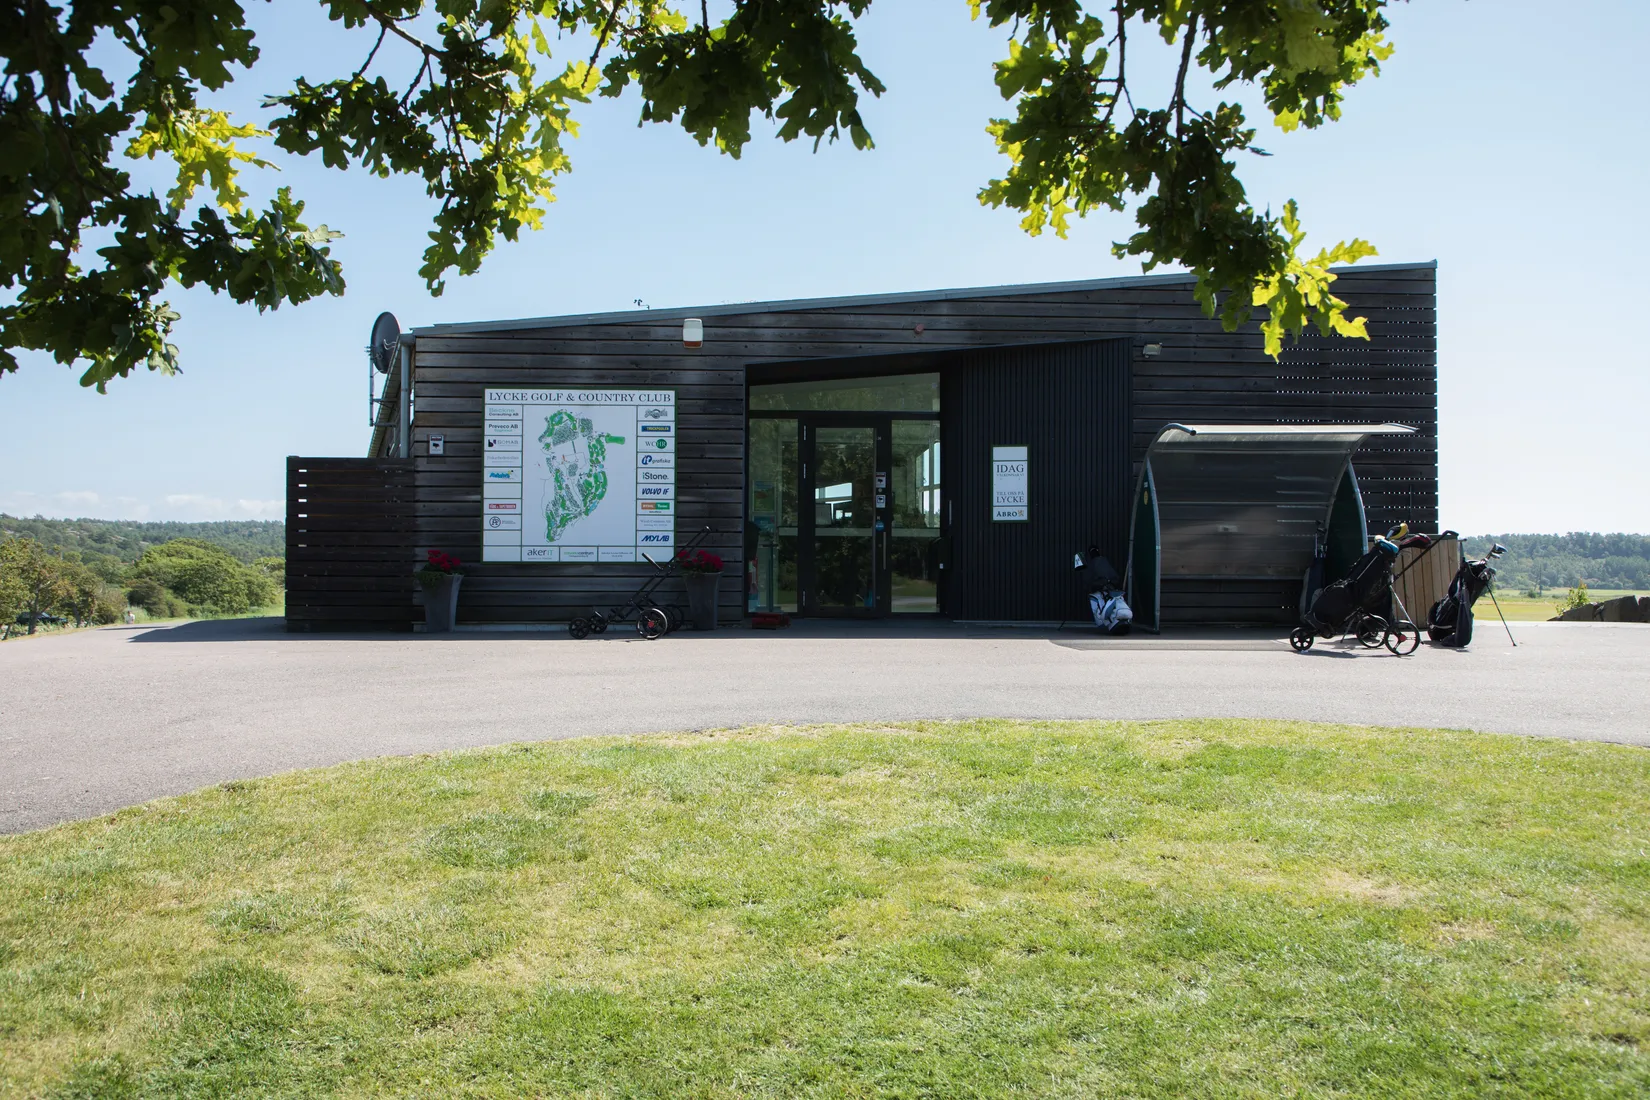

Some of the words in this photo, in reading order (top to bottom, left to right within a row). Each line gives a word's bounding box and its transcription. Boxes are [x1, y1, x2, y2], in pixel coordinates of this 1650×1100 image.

[489, 393, 528, 401] LYCKE
[531, 393, 563, 402] GOLF
[566, 393, 575, 402] &
[578, 393, 636, 402] COUNTRY
[638, 394, 671, 403] CLUB
[996, 464, 1024, 473] IDAG
